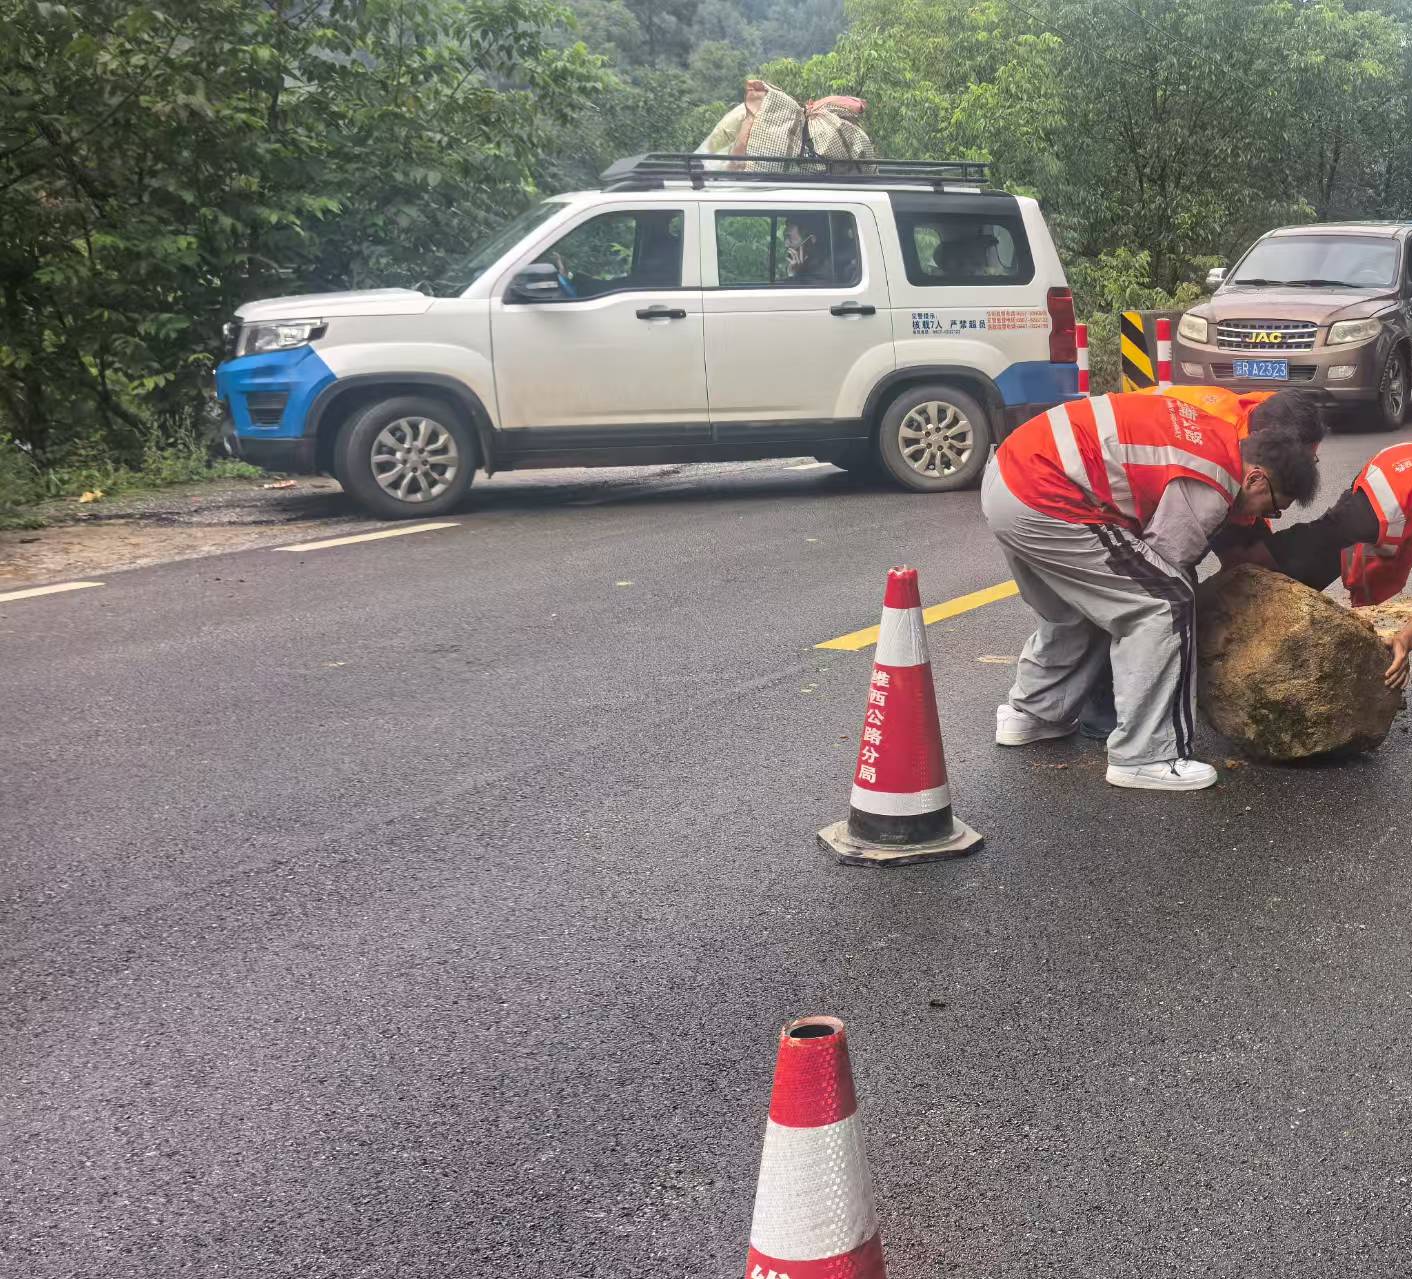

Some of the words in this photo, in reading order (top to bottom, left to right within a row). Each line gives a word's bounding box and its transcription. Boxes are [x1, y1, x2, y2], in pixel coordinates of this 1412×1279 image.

[1246, 332, 1283, 343] JAC
[858, 669, 891, 784] 维西公路分局
